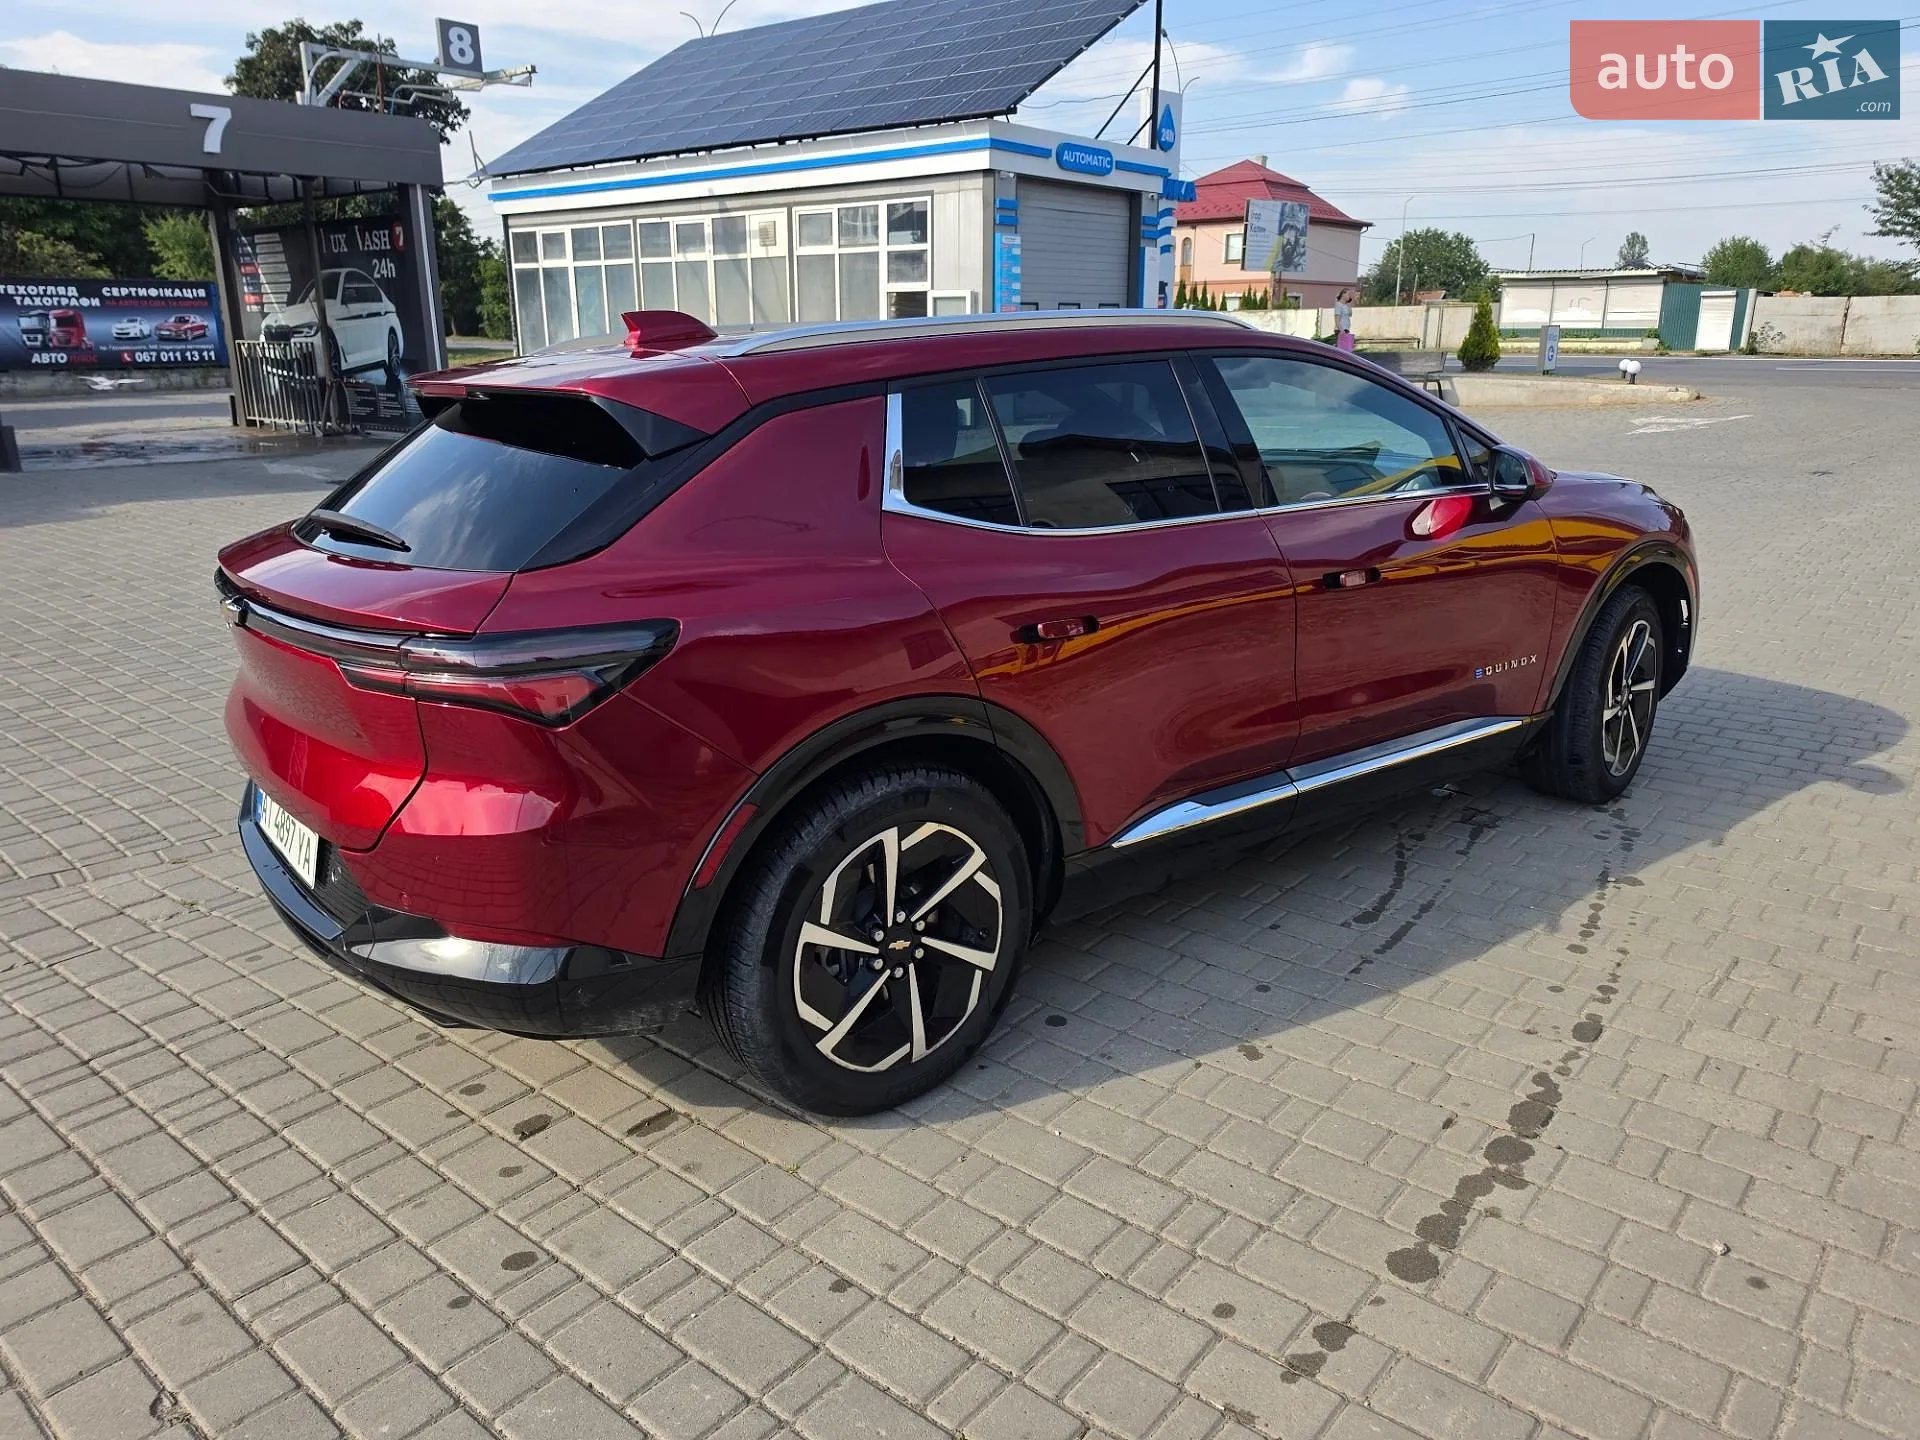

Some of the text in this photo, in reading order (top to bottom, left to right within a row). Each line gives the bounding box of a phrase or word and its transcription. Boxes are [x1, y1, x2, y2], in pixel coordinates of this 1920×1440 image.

[448, 26, 474, 64] 8
[190, 103, 232, 154] 7
[1160, 127, 1175, 143] 24h
[1062, 149, 1112, 169] AUTOMATIC
[372, 257, 397, 279] 24h
[0, 284, 79, 297] ТЕХОГЛЯД
[101, 287, 206, 299] СЕРТИФІКАЦІЯ
[13, 296, 101, 307] ТАХОГРАФИ
[31, 352, 68, 364] АВТО
[135, 350, 216, 363] 067 011 13 11
[274, 806, 297, 854] 4897
[297, 827, 312, 876] YA
